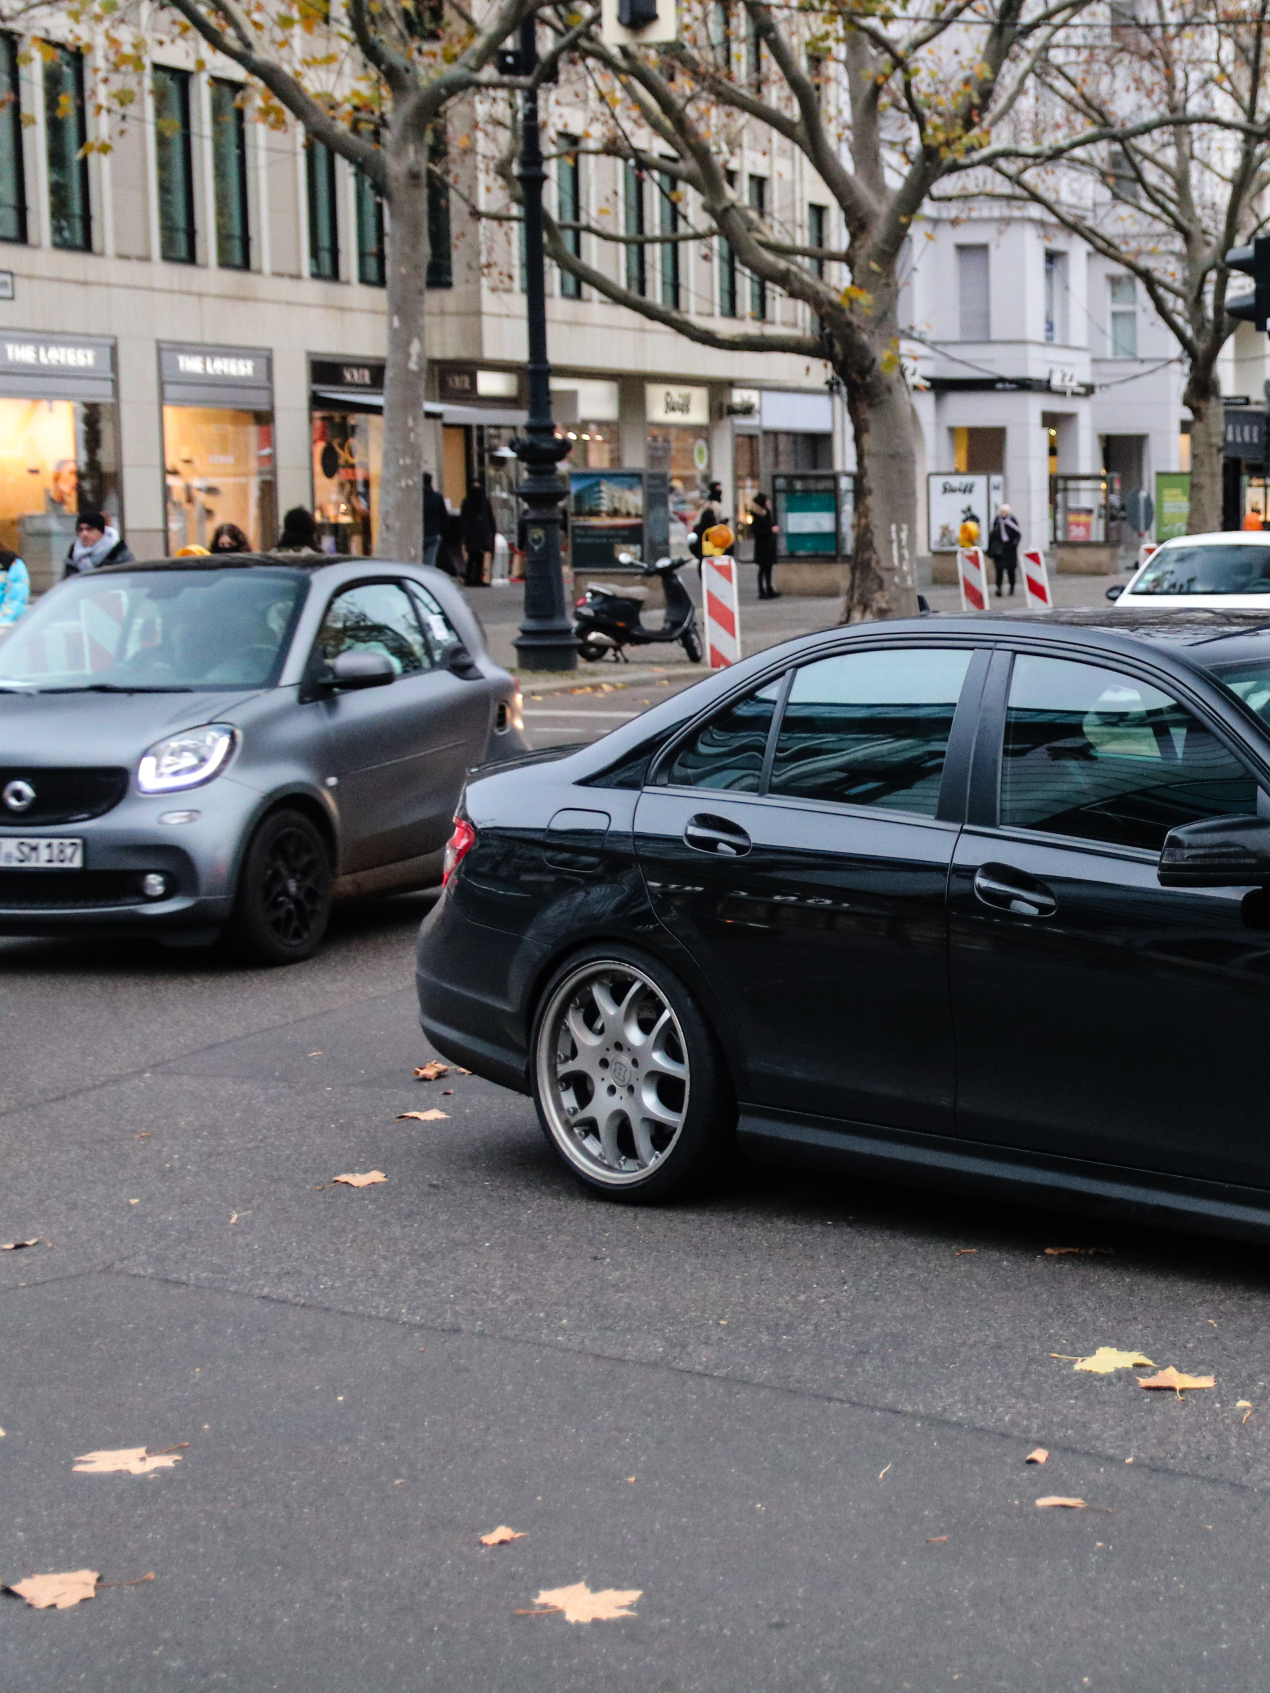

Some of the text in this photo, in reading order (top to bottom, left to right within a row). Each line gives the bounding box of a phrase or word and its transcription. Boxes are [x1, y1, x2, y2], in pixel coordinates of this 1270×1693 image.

[5, 343, 97, 367] THE LATEST
[177, 355, 204, 374] THE
[1225, 424, 1260, 444] ALKE
[45, 841, 79, 863] 187
